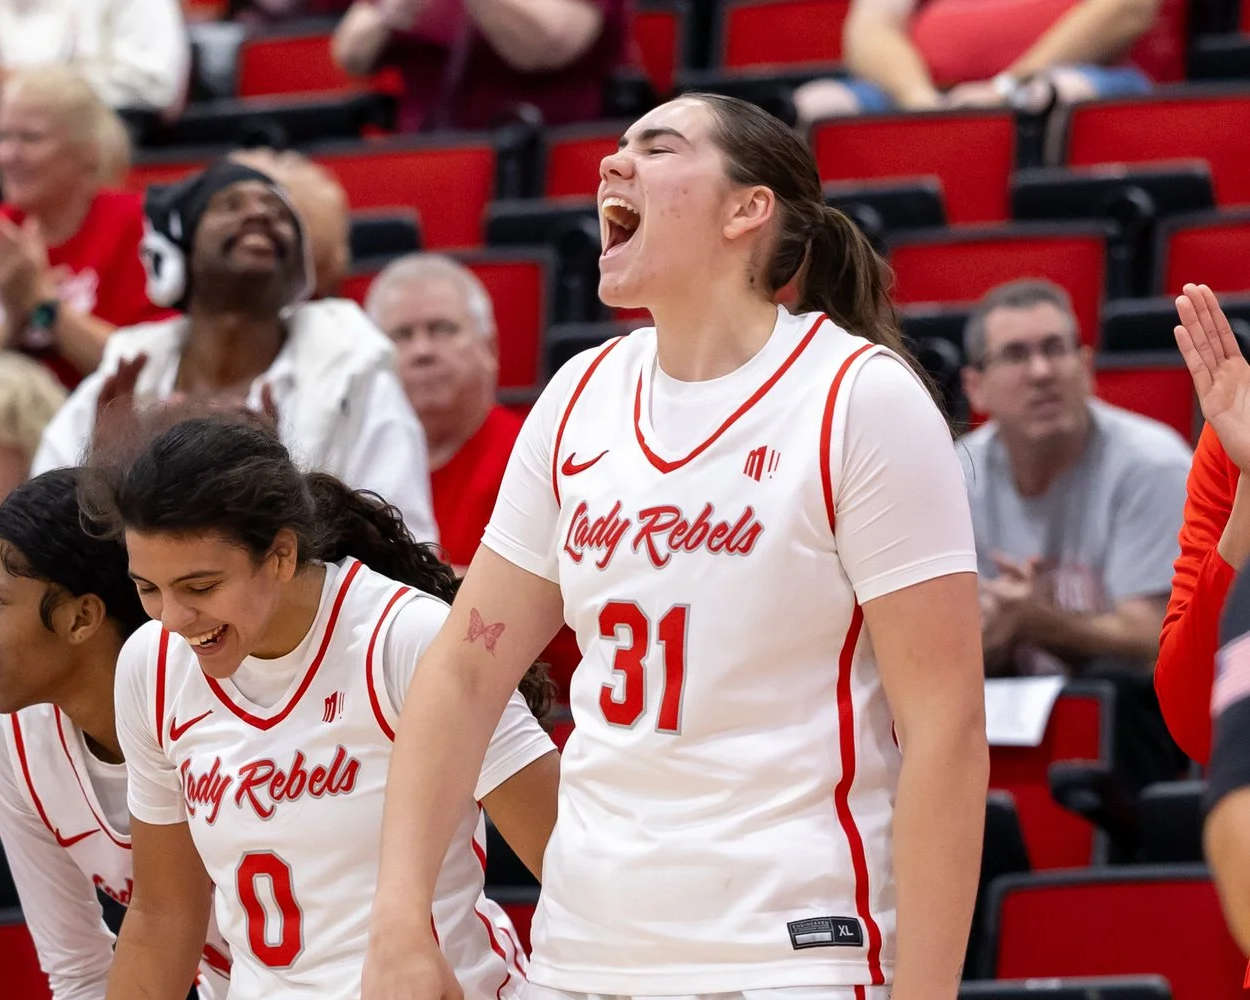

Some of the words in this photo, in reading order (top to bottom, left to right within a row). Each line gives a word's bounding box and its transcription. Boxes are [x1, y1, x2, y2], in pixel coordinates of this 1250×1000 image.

[563, 499, 633, 571] Lady
[631, 500, 765, 569] Rebels
[598, 598, 691, 737] 31
[234, 744, 362, 822] Rebels
[235, 849, 305, 970] 0
[838, 925, 854, 937] XL
